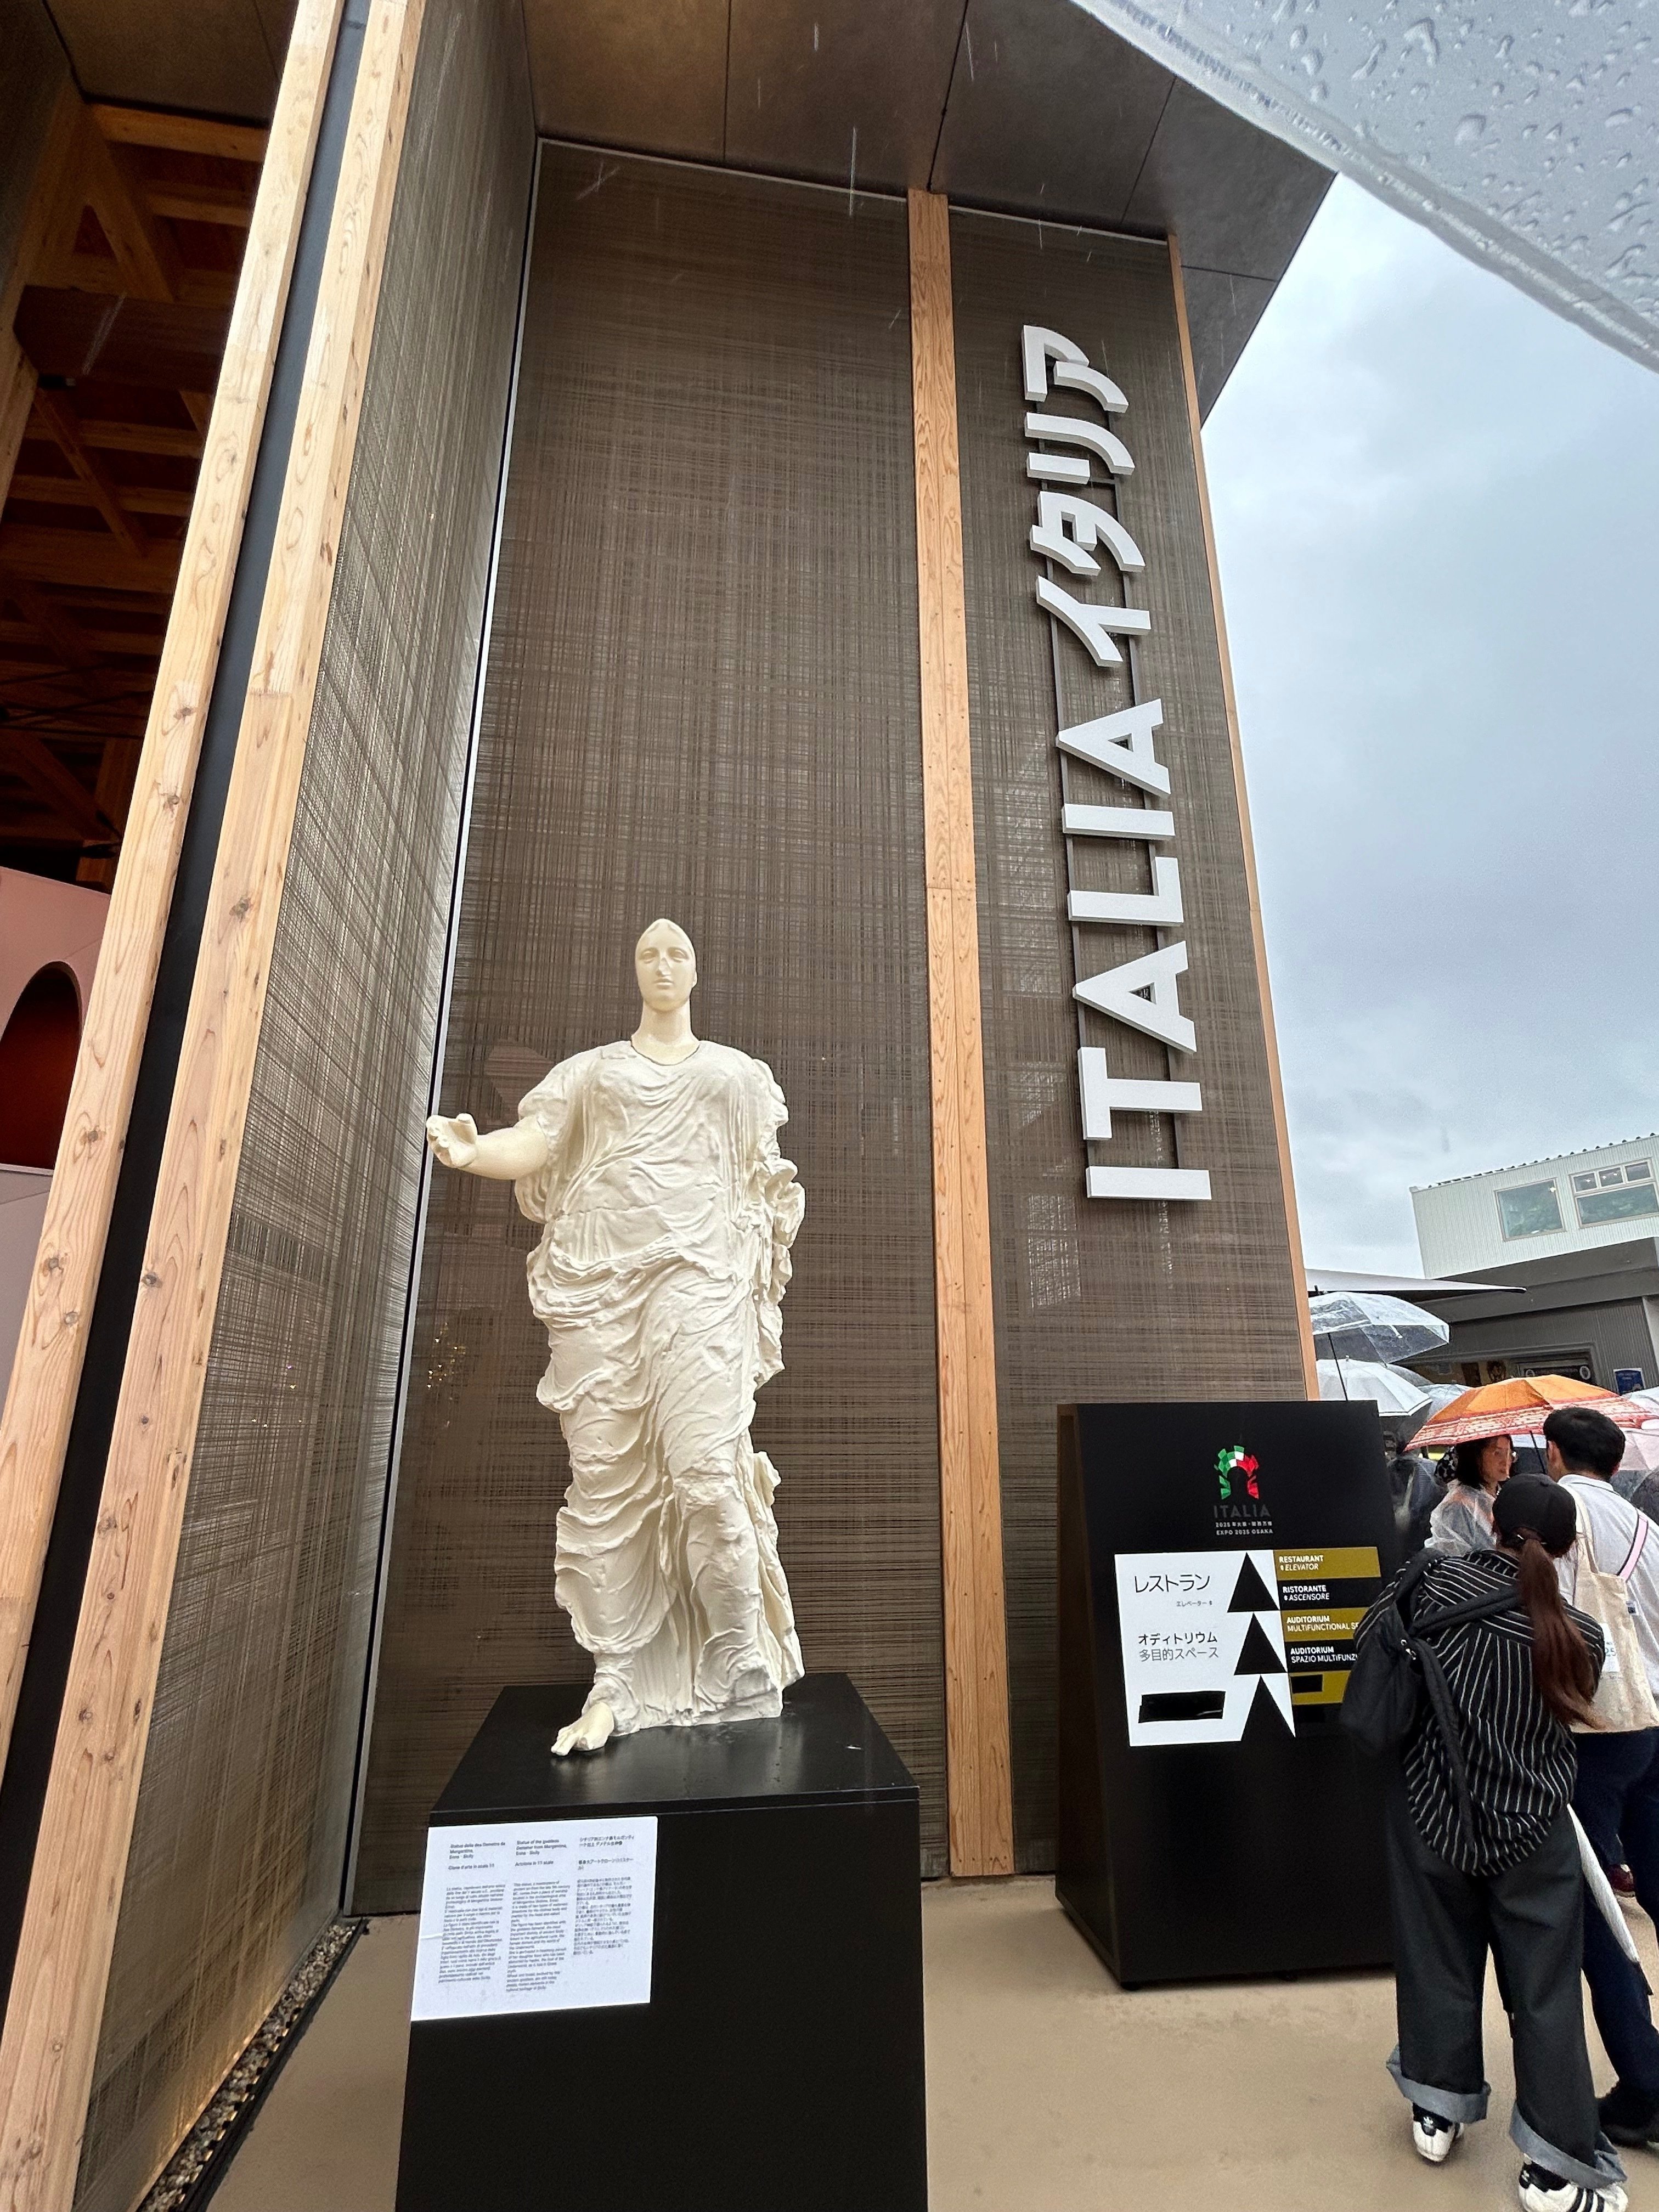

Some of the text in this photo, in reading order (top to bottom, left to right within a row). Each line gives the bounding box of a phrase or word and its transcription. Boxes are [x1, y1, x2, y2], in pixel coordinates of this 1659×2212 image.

[1022, 325, 1212, 1201] ITALIA イタリア
[1213, 1504, 1271, 1518] ITALIA
[1279, 1555, 1324, 1564] RESTAURANT
[1285, 1563, 1319, 1571] ELEVATOR
[1135, 1575, 1210, 1593] レストラン
[1283, 1585, 1327, 1593] RISTORANTE
[1289, 1593, 1330, 1601] ASCENSORE
[1286, 1615, 1330, 1624] AUDITORIUM
[1288, 1623, 1350, 1632] MULTIFUNCTIONAL
[1138, 1631, 1218, 1646] オディトリウム
[1139, 1647, 1219, 1662] 多目的スペース
[1290, 1646, 1334, 1655] AUDITORIUM
[1291, 1655, 1316, 1663] SPAZIO
